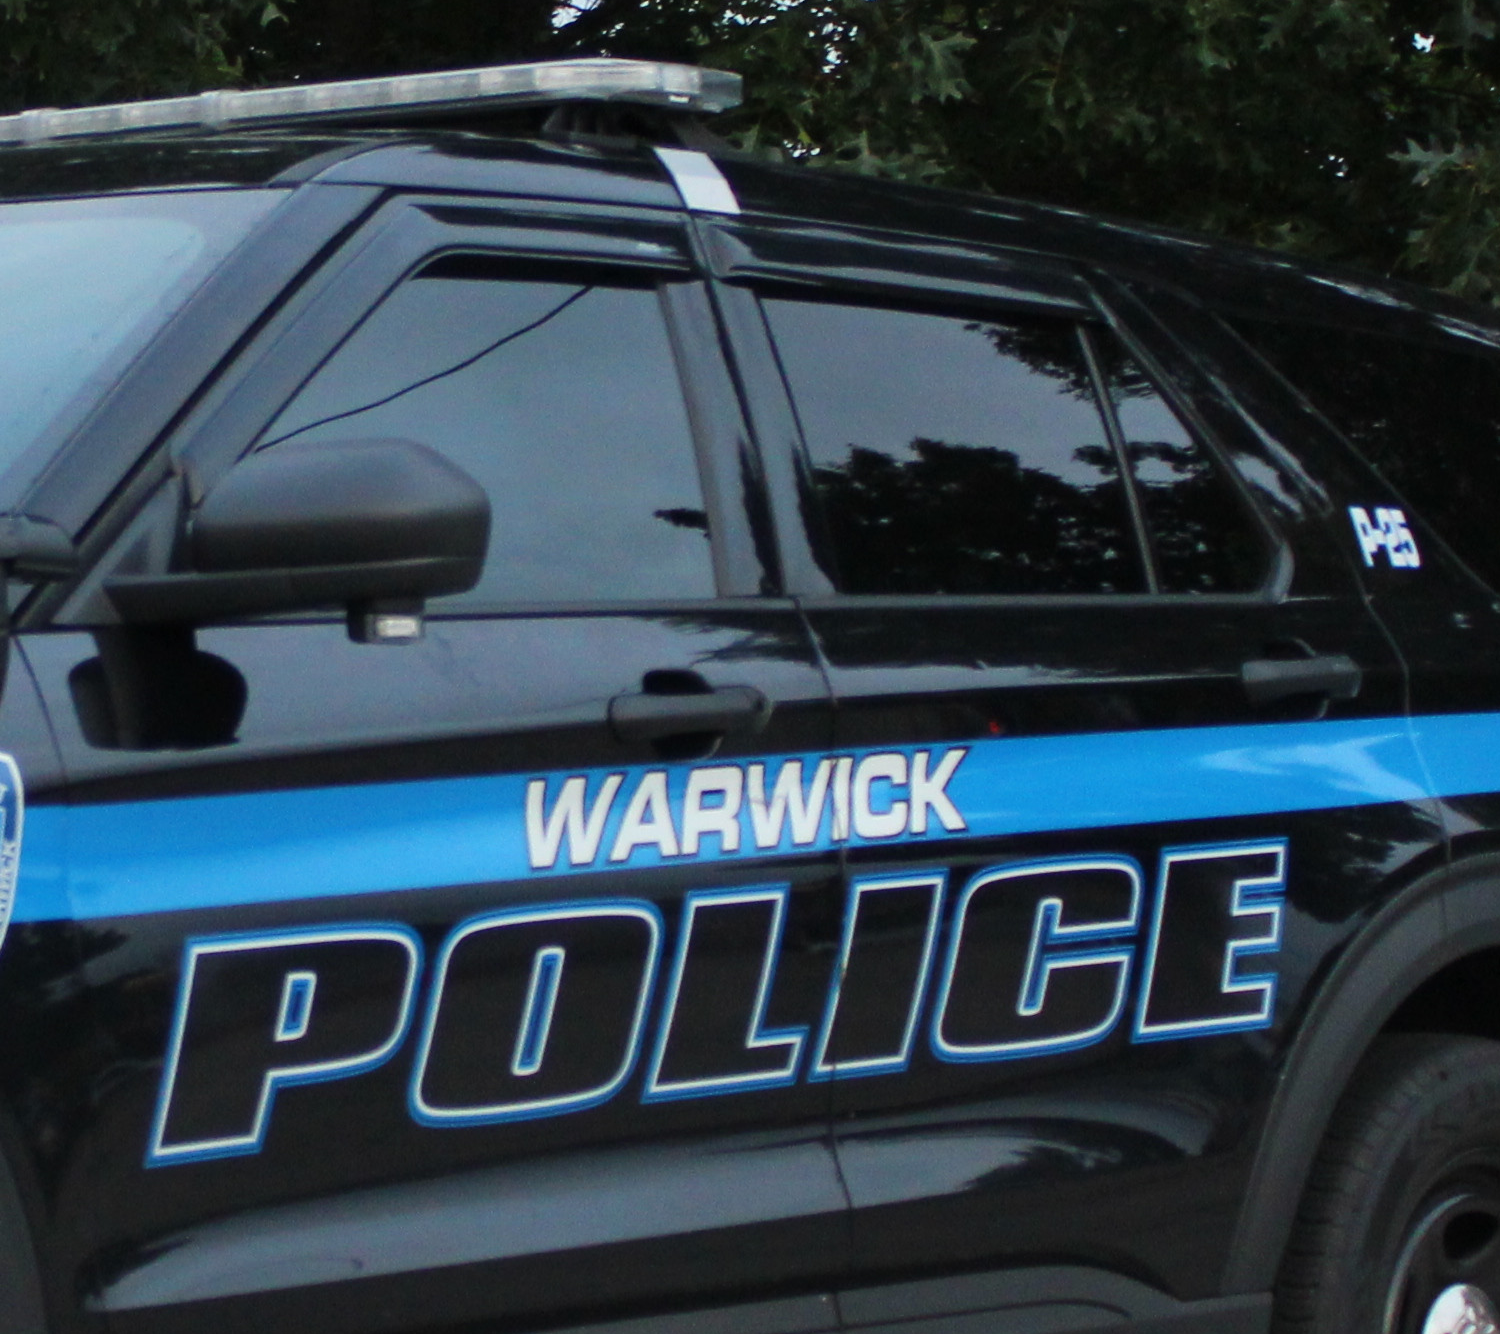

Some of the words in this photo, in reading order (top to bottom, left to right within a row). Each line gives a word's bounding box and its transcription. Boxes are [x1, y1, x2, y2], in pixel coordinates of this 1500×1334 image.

[1347, 506, 1421, 568] P-25
[525, 747, 968, 869] WARWICK
[144, 837, 1290, 1168] POLICE
